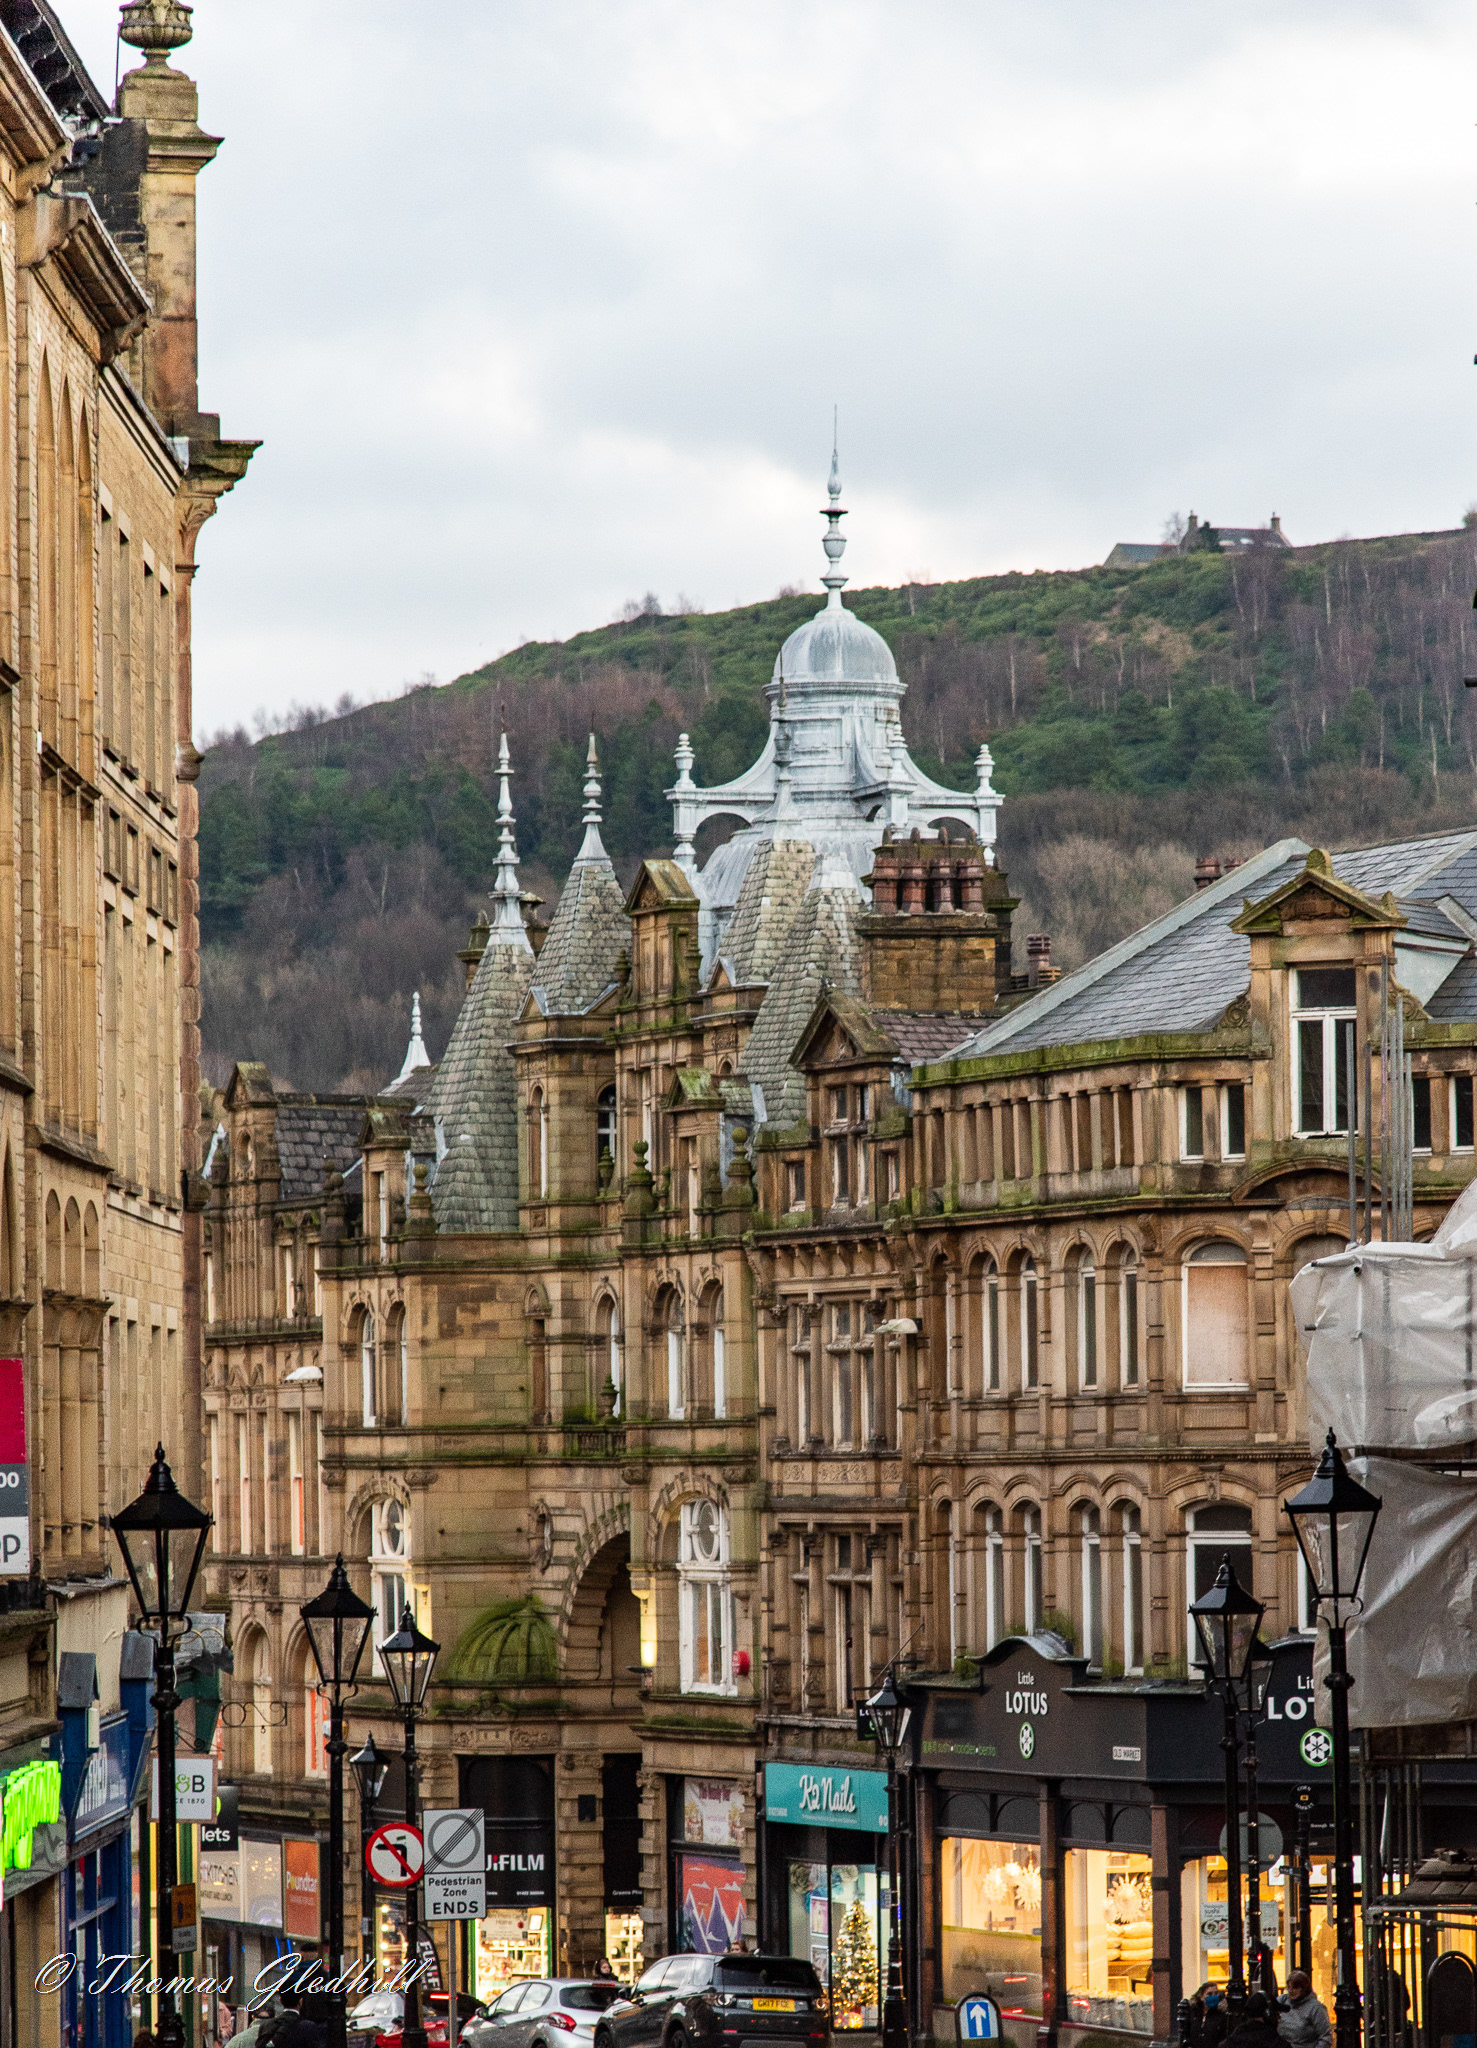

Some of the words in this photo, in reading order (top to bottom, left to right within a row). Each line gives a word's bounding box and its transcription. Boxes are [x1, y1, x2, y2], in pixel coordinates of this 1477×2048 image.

[1017, 1671, 1035, 1685] Little
[1005, 1690, 1048, 1715] LOTUS
[1122, 1748, 1141, 1760] MARKET
[821, 1776, 856, 1813] Nails
[201, 1826, 231, 1842] lets
[428, 1876, 482, 1887] Pedestrian
[442, 1888, 468, 1897] Zone
[433, 1901, 479, 1915] ENDS
